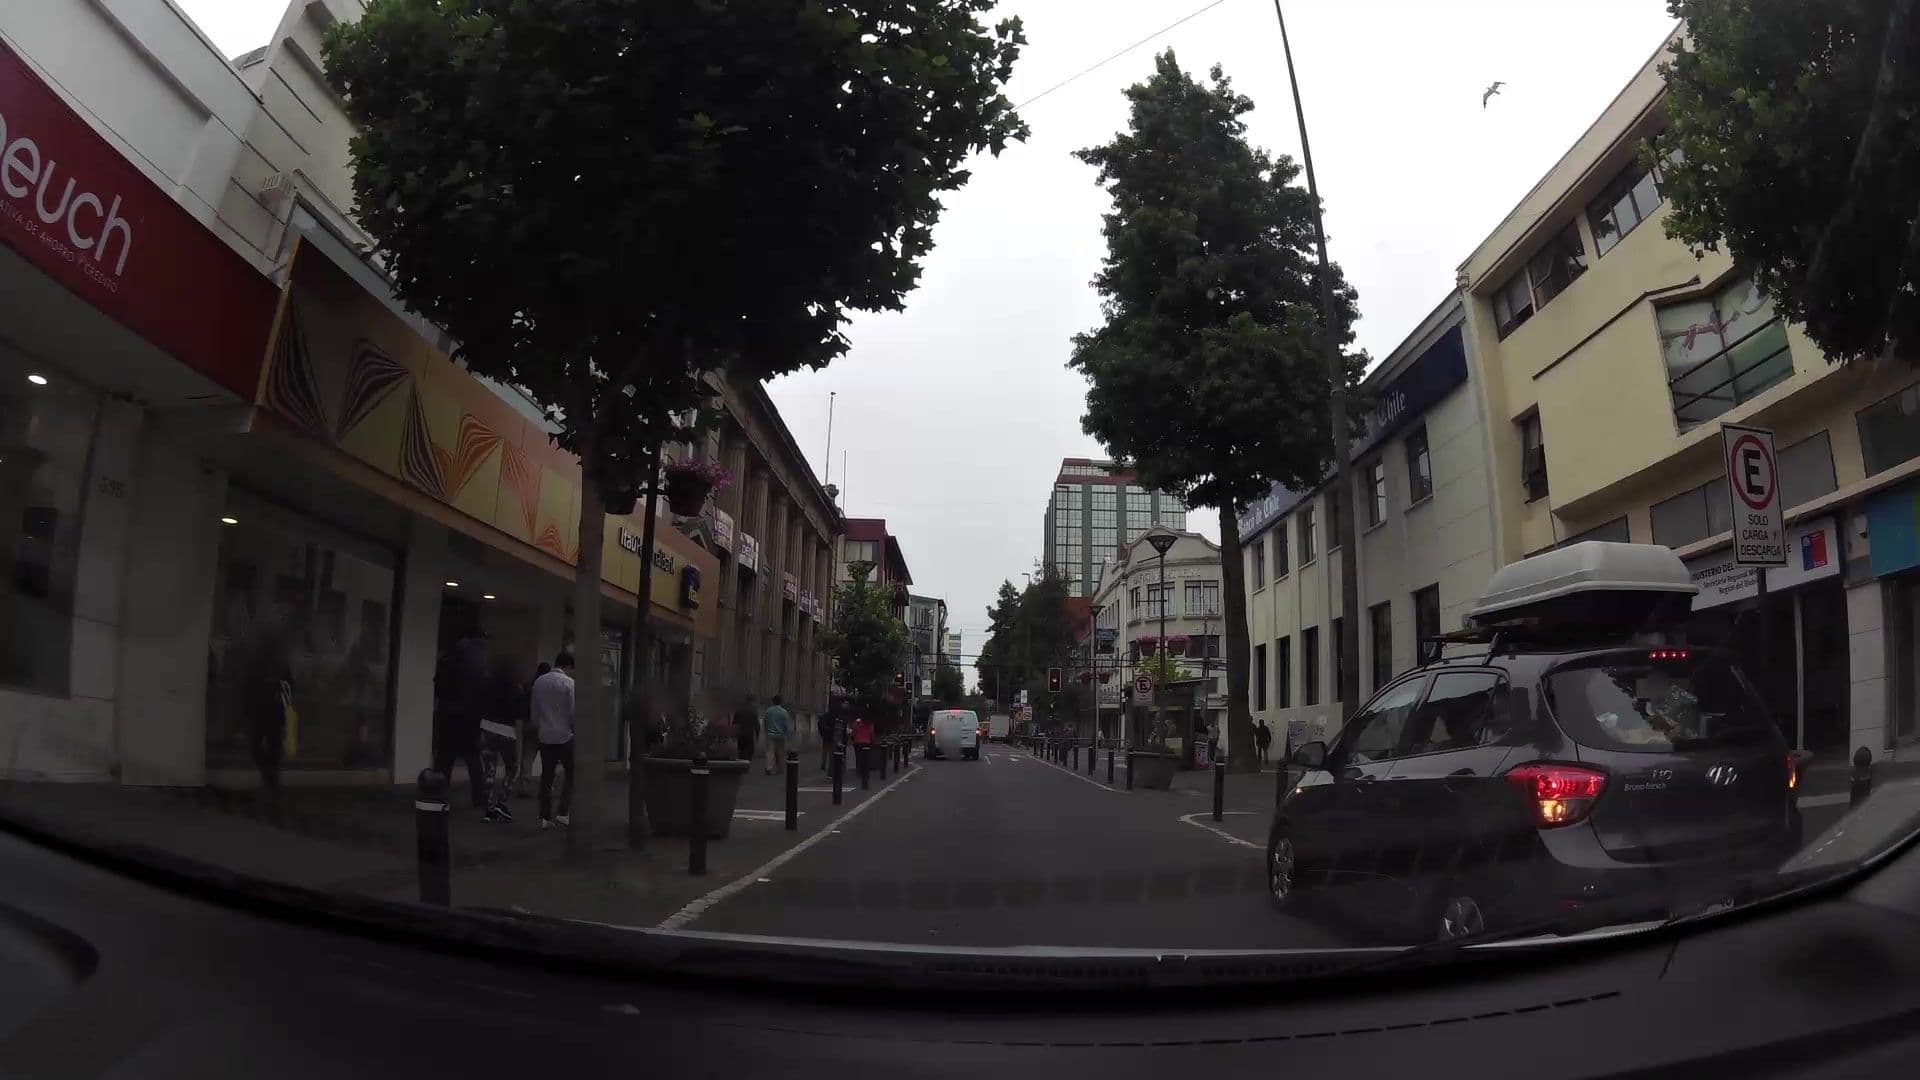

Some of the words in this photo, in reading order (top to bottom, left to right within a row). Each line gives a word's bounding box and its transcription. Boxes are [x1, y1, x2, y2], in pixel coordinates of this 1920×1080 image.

[0, 113, 131, 277] euch
[26, 220, 39, 236] DE
[1376, 391, 1406, 427] Chile
[1743, 448, 1765, 495] E
[1747, 514, 1769, 526] SOLO
[1742, 529, 1769, 541] CARGA
[1741, 544, 1782, 556] DESCARGA
[1722, 562, 1735, 574] DEL
